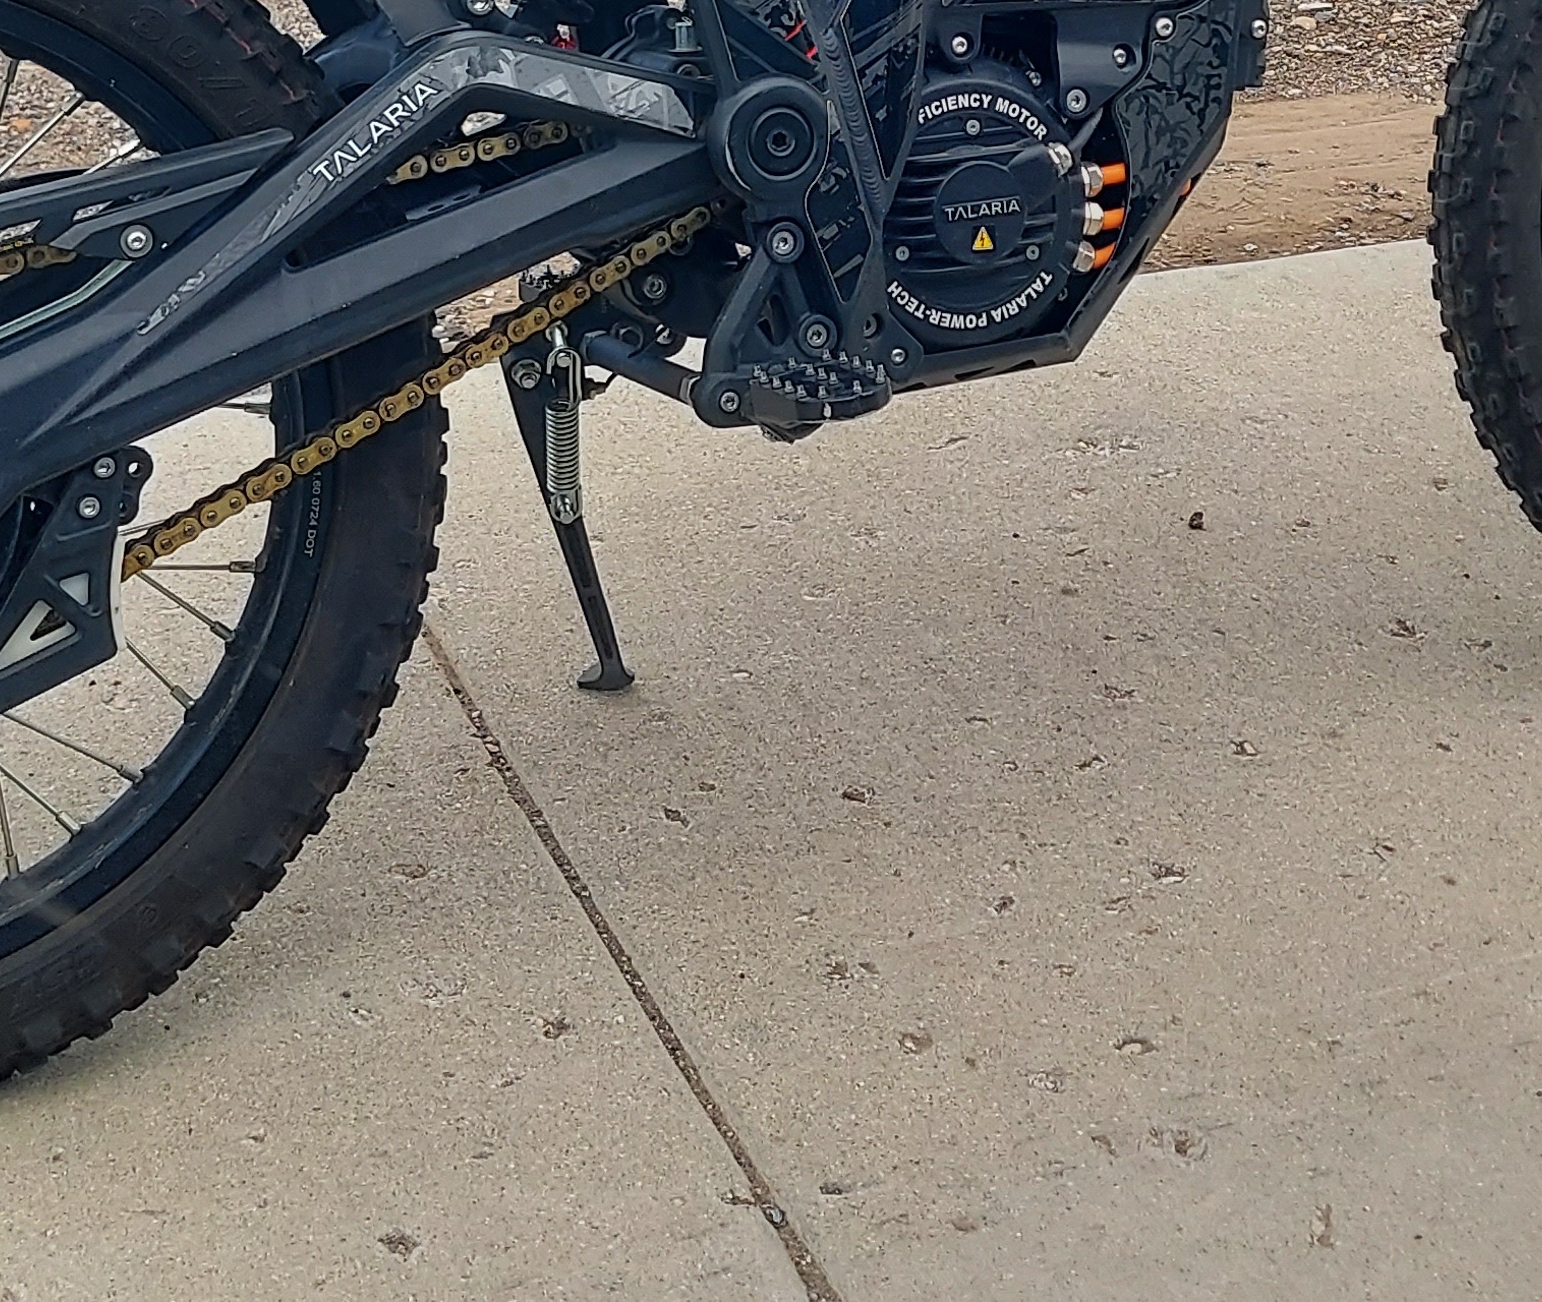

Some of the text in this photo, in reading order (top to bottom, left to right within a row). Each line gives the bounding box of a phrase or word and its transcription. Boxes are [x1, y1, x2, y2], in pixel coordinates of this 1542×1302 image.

[312, 82, 439, 182] TALARIA
[995, 97, 1048, 141] MOTOR
[944, 199, 1021, 222] TALARIA
[887, 271, 1053, 330] TALARIA POWER-TECH
[308, 497, 321, 527] 0724
[303, 529, 317, 559] DOT
